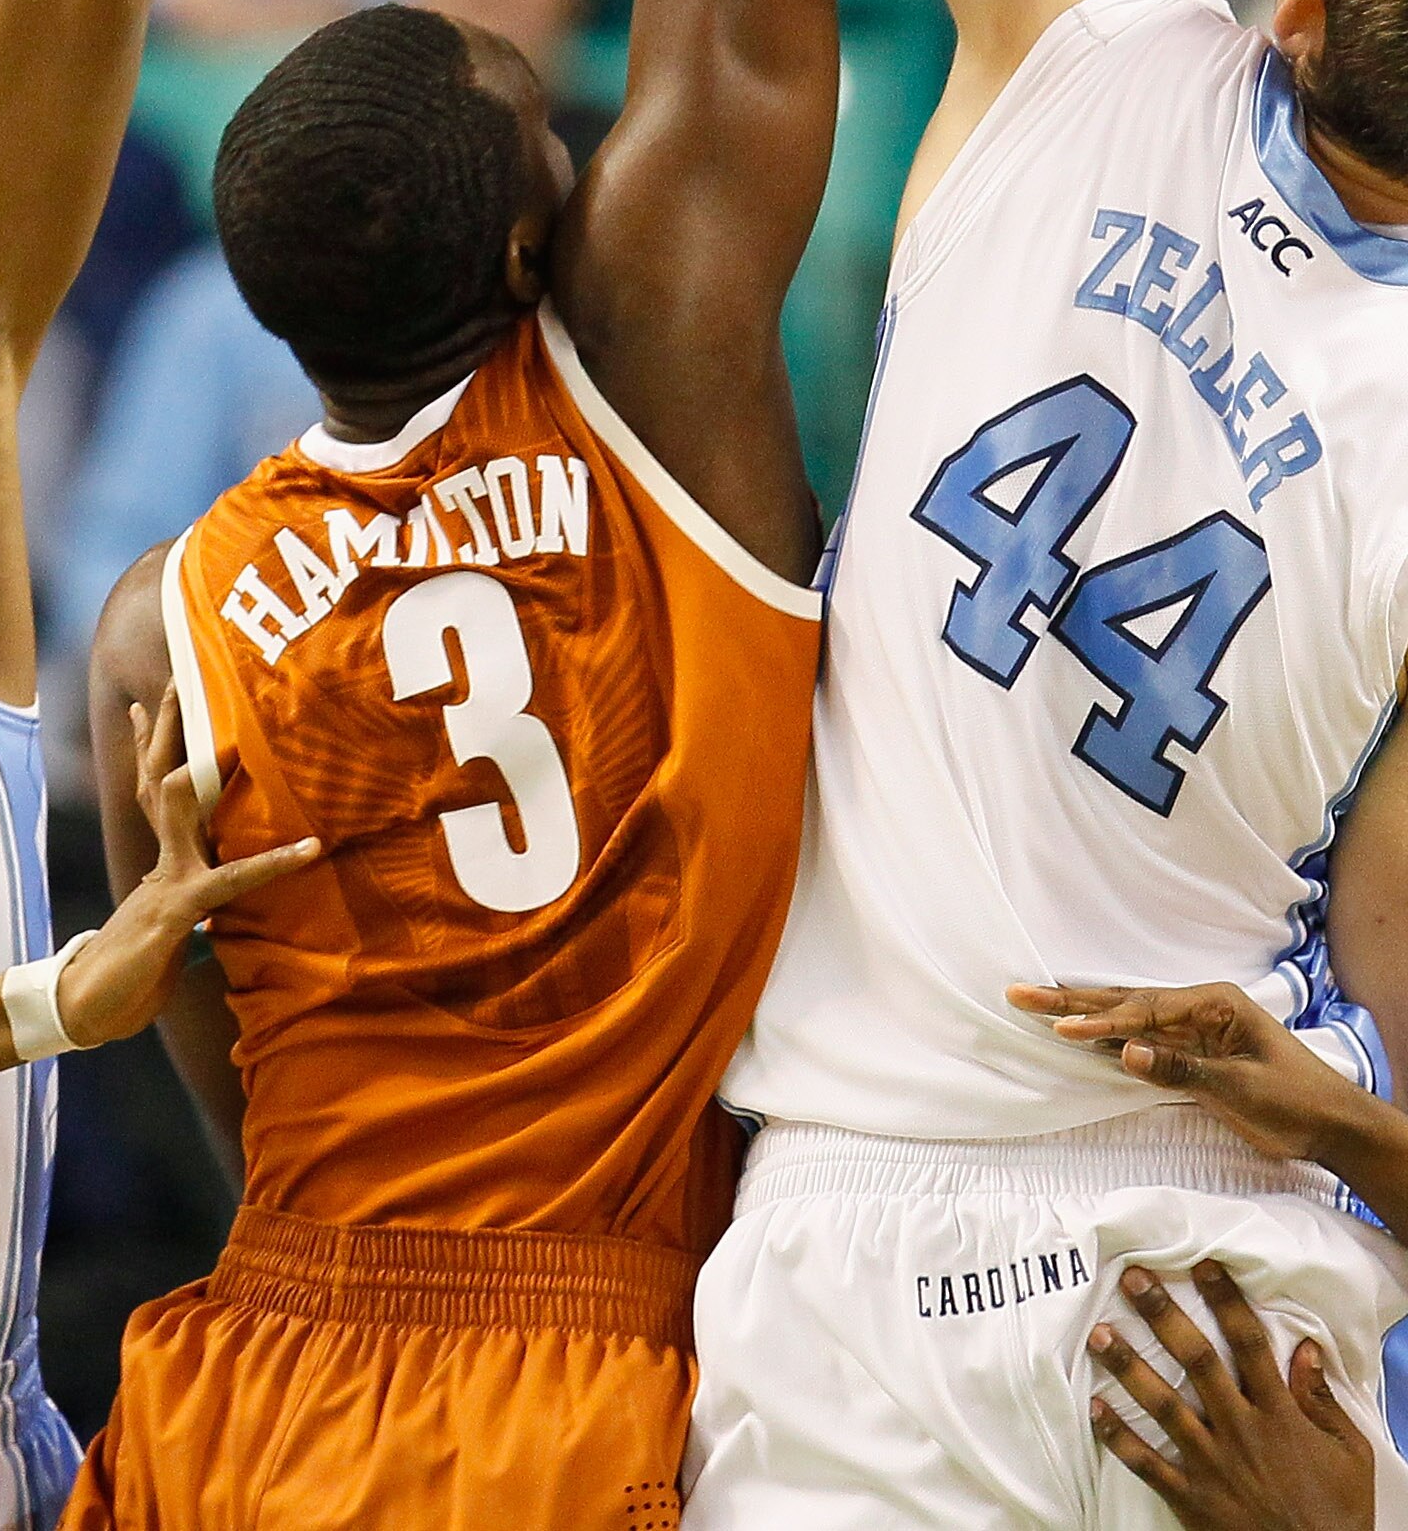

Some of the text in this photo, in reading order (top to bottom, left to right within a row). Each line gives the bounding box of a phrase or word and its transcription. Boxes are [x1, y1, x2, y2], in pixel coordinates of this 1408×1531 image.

[1227, 197, 1315, 278] ACC
[910, 373, 1273, 818] 44
[382, 570, 581, 914] 3
[917, 1247, 1090, 1318] CAROLINA
